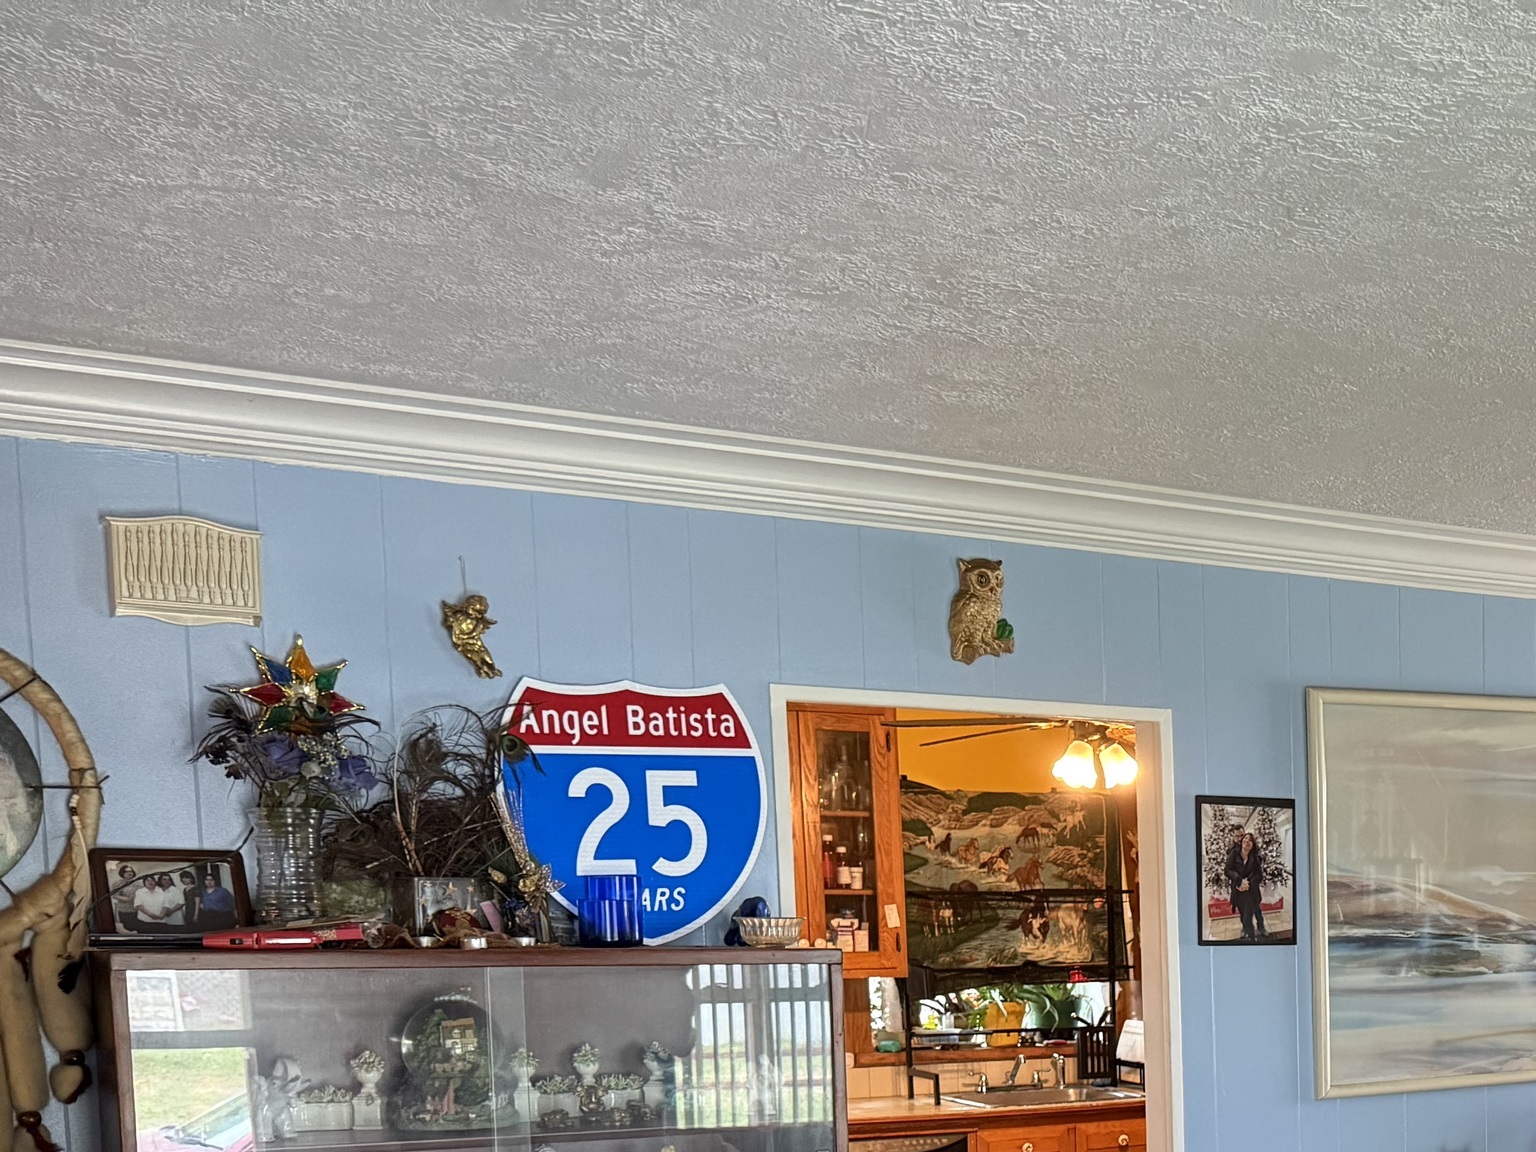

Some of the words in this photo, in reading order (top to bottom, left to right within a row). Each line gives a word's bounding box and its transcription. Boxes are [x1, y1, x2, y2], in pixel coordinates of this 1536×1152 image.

[519, 702, 609, 745] Angel
[626, 704, 736, 738] Batista
[568, 767, 708, 877] 25
[641, 887, 686, 912] ARS
